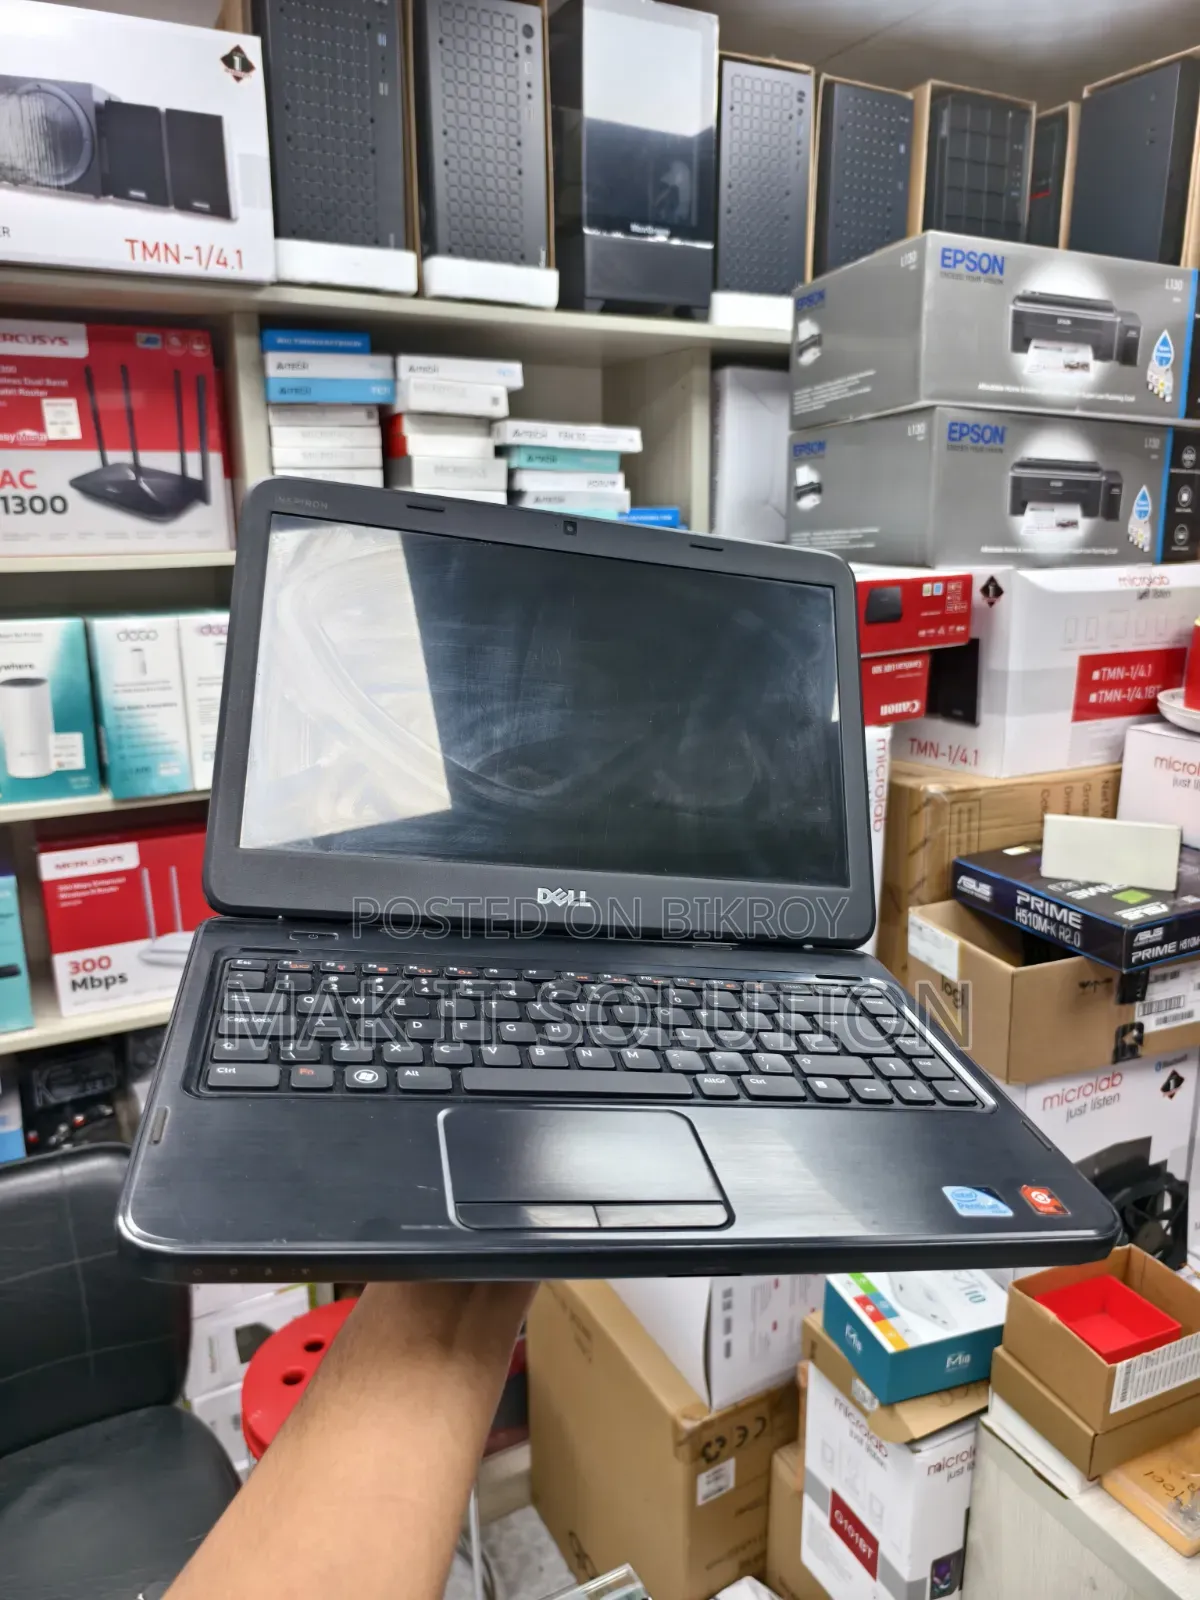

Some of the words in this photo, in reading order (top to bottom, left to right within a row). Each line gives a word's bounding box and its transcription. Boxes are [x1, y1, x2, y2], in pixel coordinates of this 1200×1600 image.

[125, 239, 244, 271] TMN-1/4.1
[941, 248, 1005, 276] EPSON
[947, 422, 1006, 446] EPSON
[0, 469, 37, 489] AC
[3, 495, 68, 515] 1300
[1100, 663, 1153, 682] TMN-1/4.1
[880, 700, 921, 716] Canon
[909, 738, 978, 767] TMN-1/4.1
[873, 738, 887, 832] microlab
[957, 874, 993, 897] ASUS
[537, 887, 591, 908] DELL
[1016, 889, 1083, 930] PRIME
[1015, 906, 1057, 937] H510M-K
[1133, 926, 1164, 941] ASUS
[1131, 941, 1177, 964] PRIME
[69, 956, 112, 975] 300
[71, 972, 129, 993] Mbps
[941, 975, 964, 1009] logi
[351, 997, 366, 1005] W
[397, 998, 406, 1006] E
[412, 1021, 423, 1029] D
[459, 1022, 469, 1030] F
[506, 1024, 517, 1032] G
[551, 1025, 561, 1033] H
[340, 1042, 351, 1051] Z
[390, 1043, 402, 1052] X
[440, 1045, 451, 1053] C
[487, 1046, 498, 1054] V
[535, 1047, 546, 1056] B
[581, 1049, 593, 1057] N
[626, 1050, 639, 1059] M
[216, 1066, 237, 1074] Ctrl
[298, 1067, 316, 1076] Fn
[404, 1069, 420, 1077] Alt
[1042, 1071, 1123, 1111] microlab
[1066, 1103, 1087, 1123] just
[1090, 1091, 1121, 1111] listen
